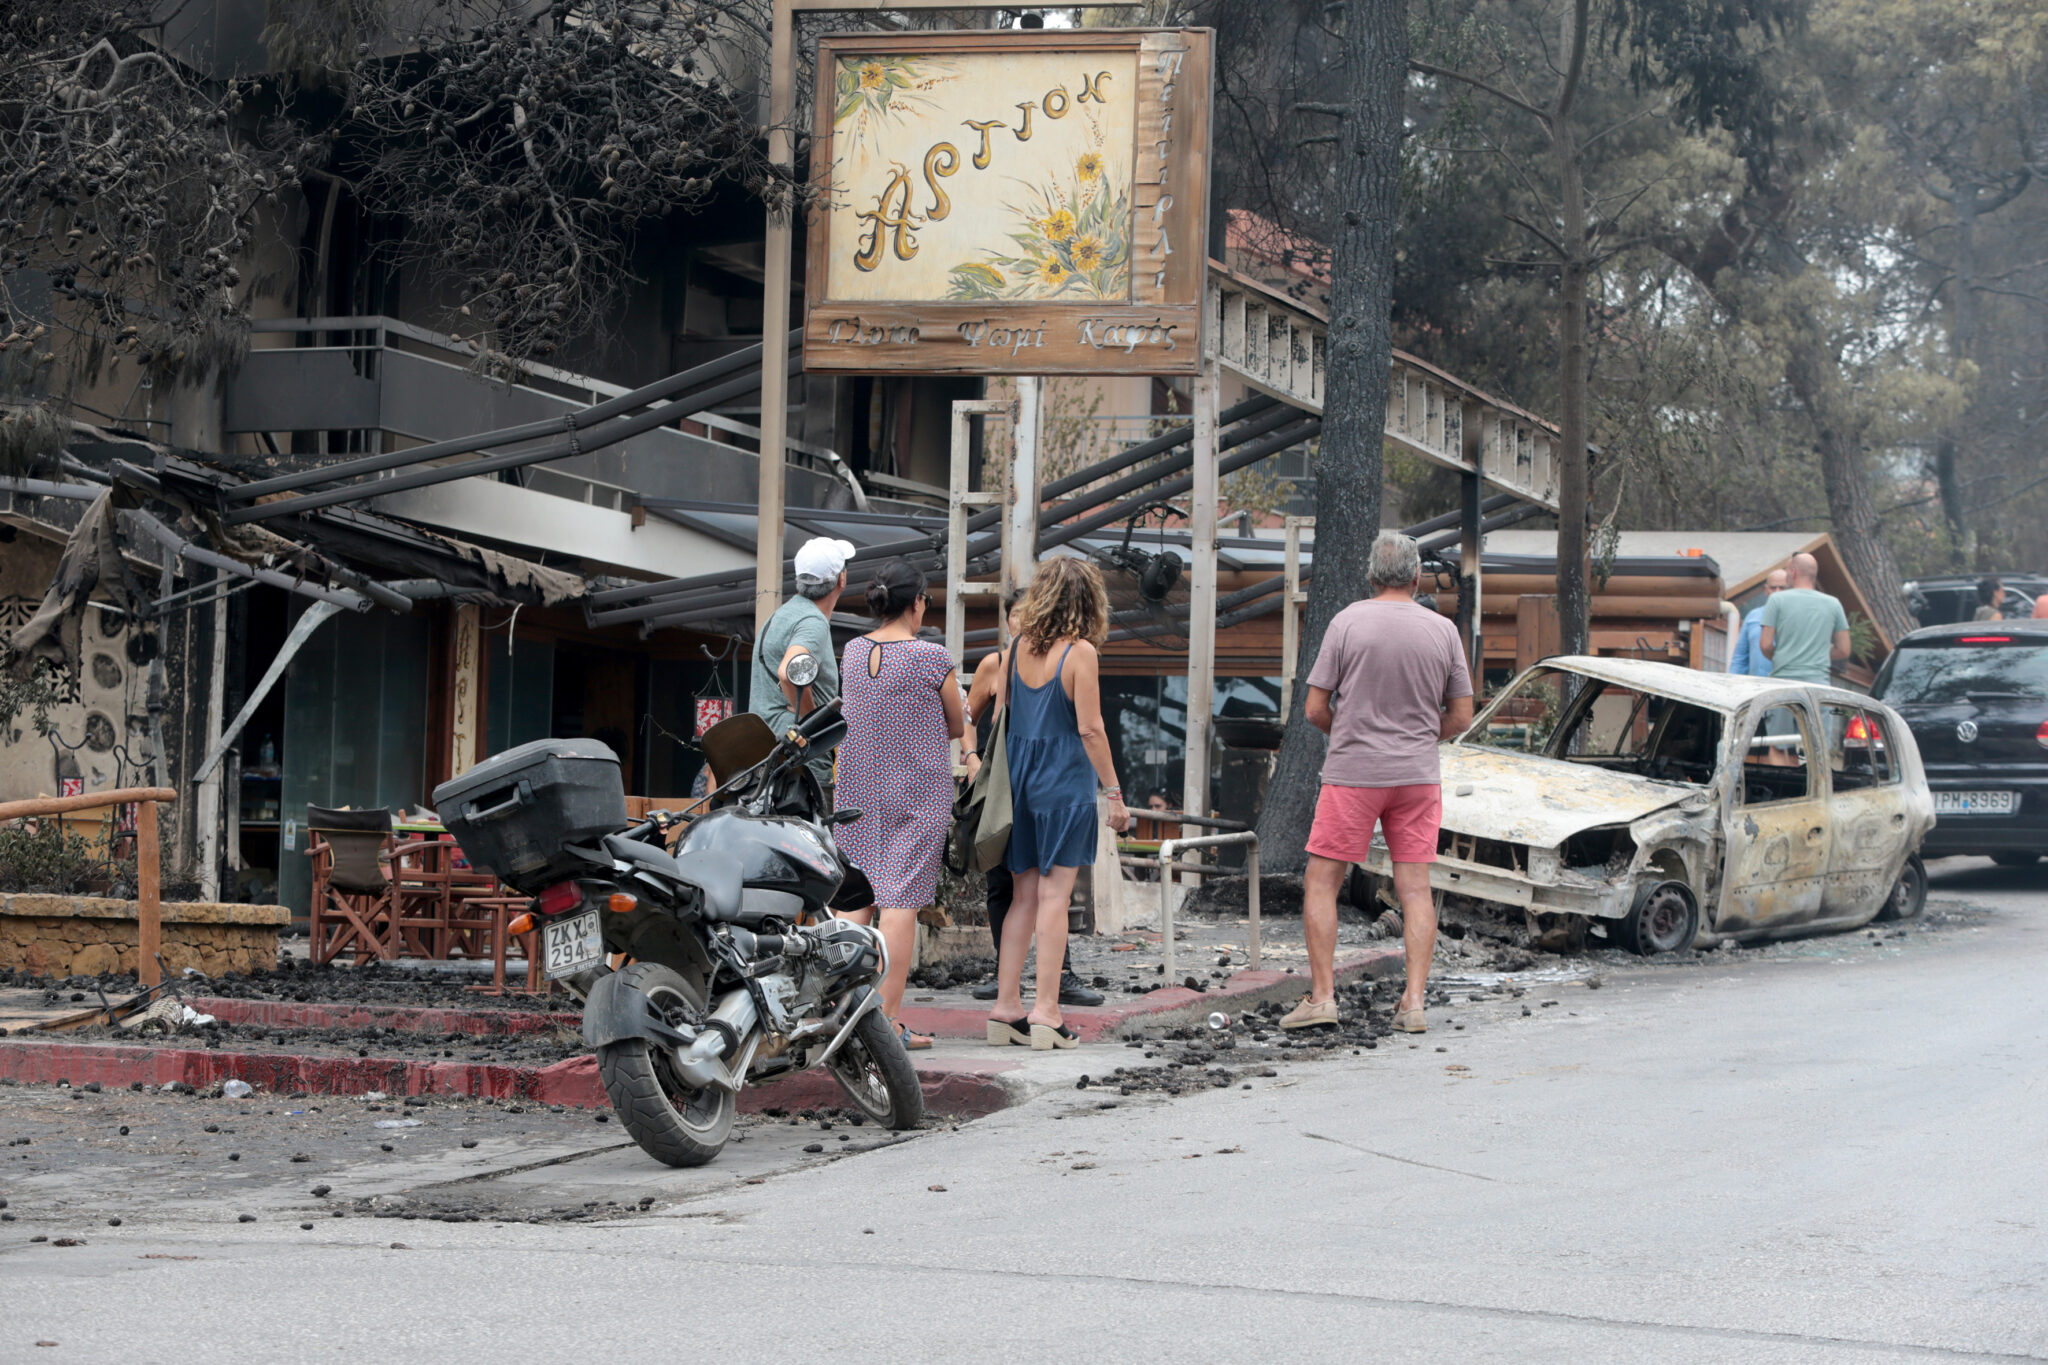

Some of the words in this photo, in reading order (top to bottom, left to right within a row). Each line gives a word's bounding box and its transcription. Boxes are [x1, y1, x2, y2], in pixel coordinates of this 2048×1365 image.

[957, 318, 1047, 356] Ψωμί
[1076, 316, 1178, 354] Καφές
[1970, 792, 2009, 808] 8969
[550, 919, 583, 948] ZKX
[551, 941, 584, 968] 294
